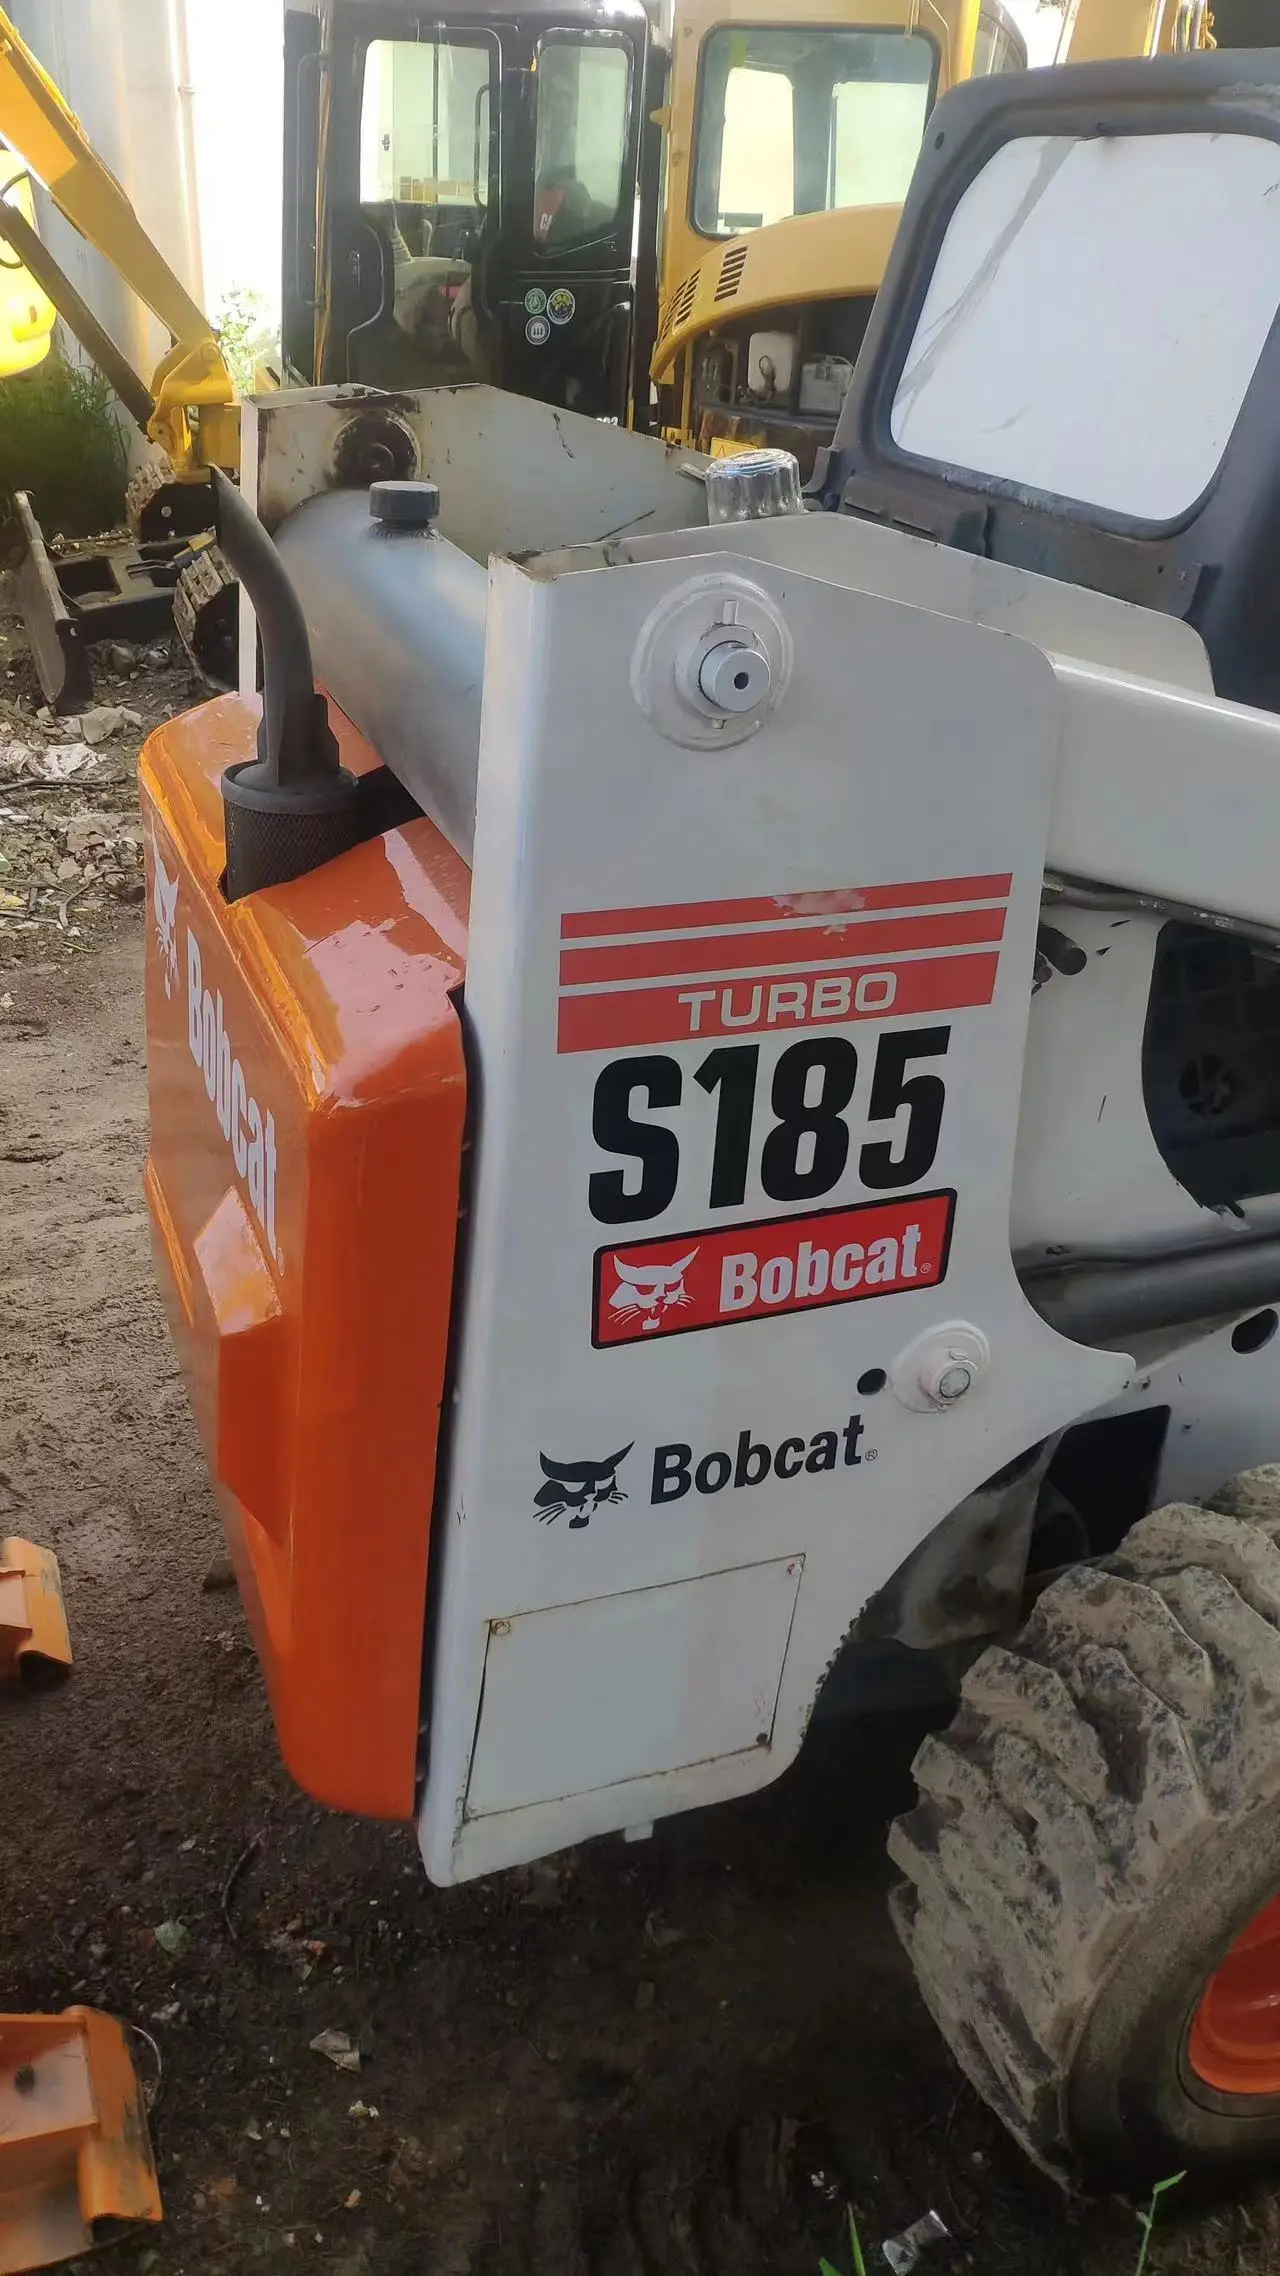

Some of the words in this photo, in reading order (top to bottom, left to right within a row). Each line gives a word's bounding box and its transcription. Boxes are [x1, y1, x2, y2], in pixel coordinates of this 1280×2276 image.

[678, 971, 898, 1031] TURBO
[187, 925, 278, 1261] Bobcat
[588, 1025, 952, 1224] S185
[718, 1224, 922, 1313] Bobcat
[650, 1415, 866, 1504] Bobcat
